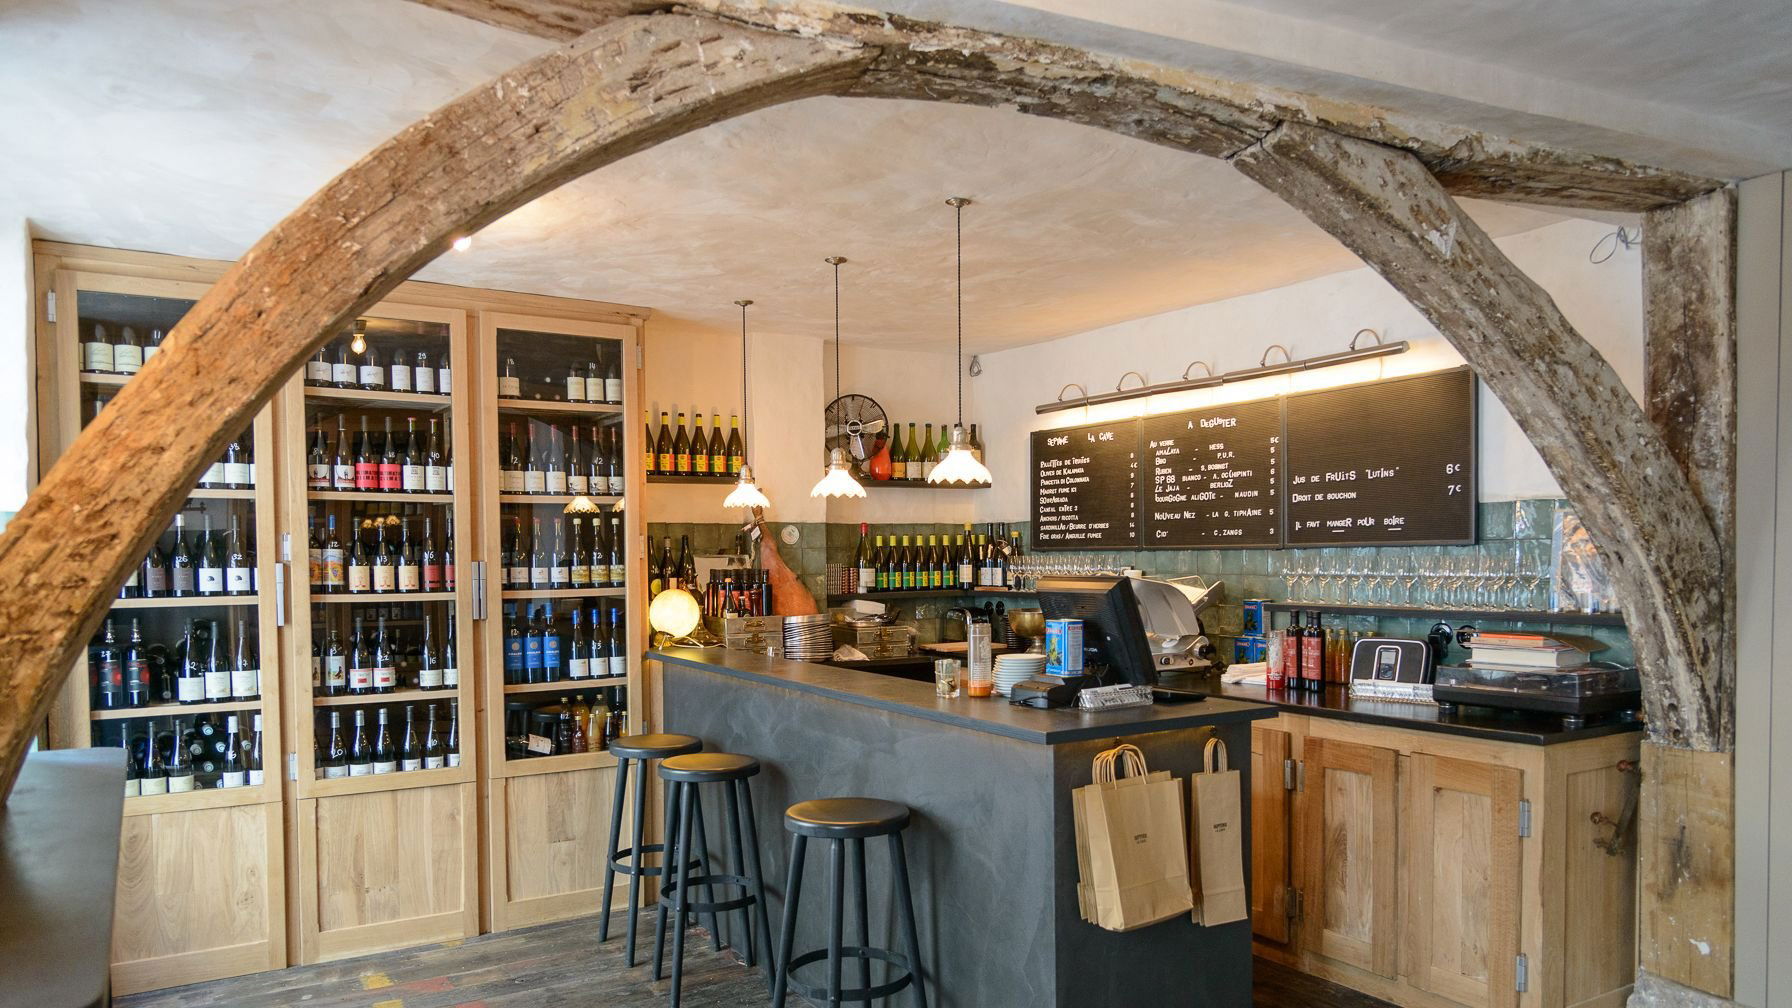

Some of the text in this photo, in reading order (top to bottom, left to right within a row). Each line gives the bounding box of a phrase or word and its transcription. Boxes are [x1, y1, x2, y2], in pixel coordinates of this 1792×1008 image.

[1187, 421, 1194, 429] A
[1088, 433, 1095, 443] LA
[1099, 432, 1114, 441] CAVE
[1292, 475, 1306, 485] JUS
[1311, 475, 1320, 483] DE
[1154, 485, 1163, 493] LE
[1165, 484, 1180, 492] JAJA
[1234, 490, 1259, 498] NAUDIN
[1292, 484, 1462, 503] DROIT DE BOUCHON 7€
[1183, 511, 1196, 519] NEZ
[1295, 521, 1302, 531] IL
[1327, 518, 1352, 527] MANGER
[1357, 517, 1375, 527] POUR
[1384, 515, 1405, 525] BOIRE
